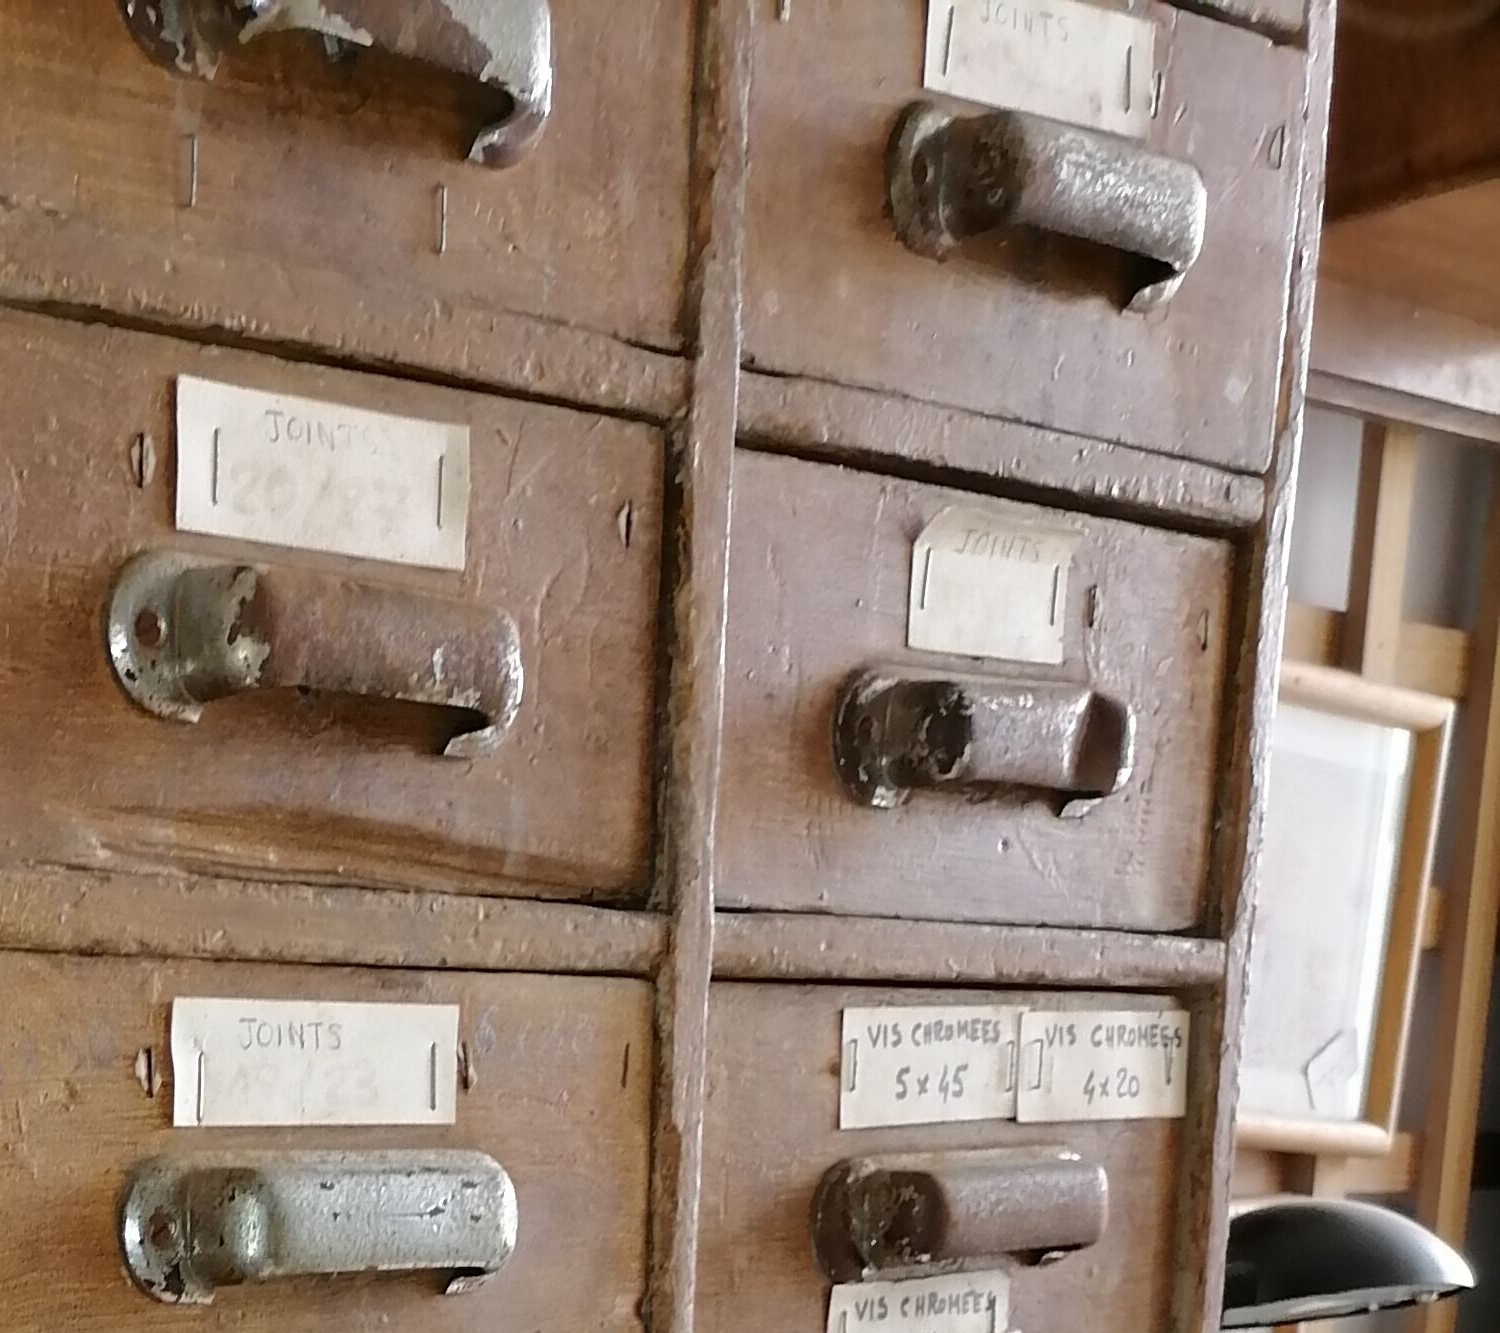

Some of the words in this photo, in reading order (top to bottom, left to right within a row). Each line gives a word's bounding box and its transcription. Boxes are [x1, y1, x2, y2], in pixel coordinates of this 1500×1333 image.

[264, 408, 378, 454] JOINTS
[955, 528, 1043, 563] JOINTS
[238, 1016, 343, 1052] JOINTS
[867, 1023, 902, 1049] VIS
[1045, 1021, 1077, 1048] VIS
[854, 1295, 889, 1322] VIS
